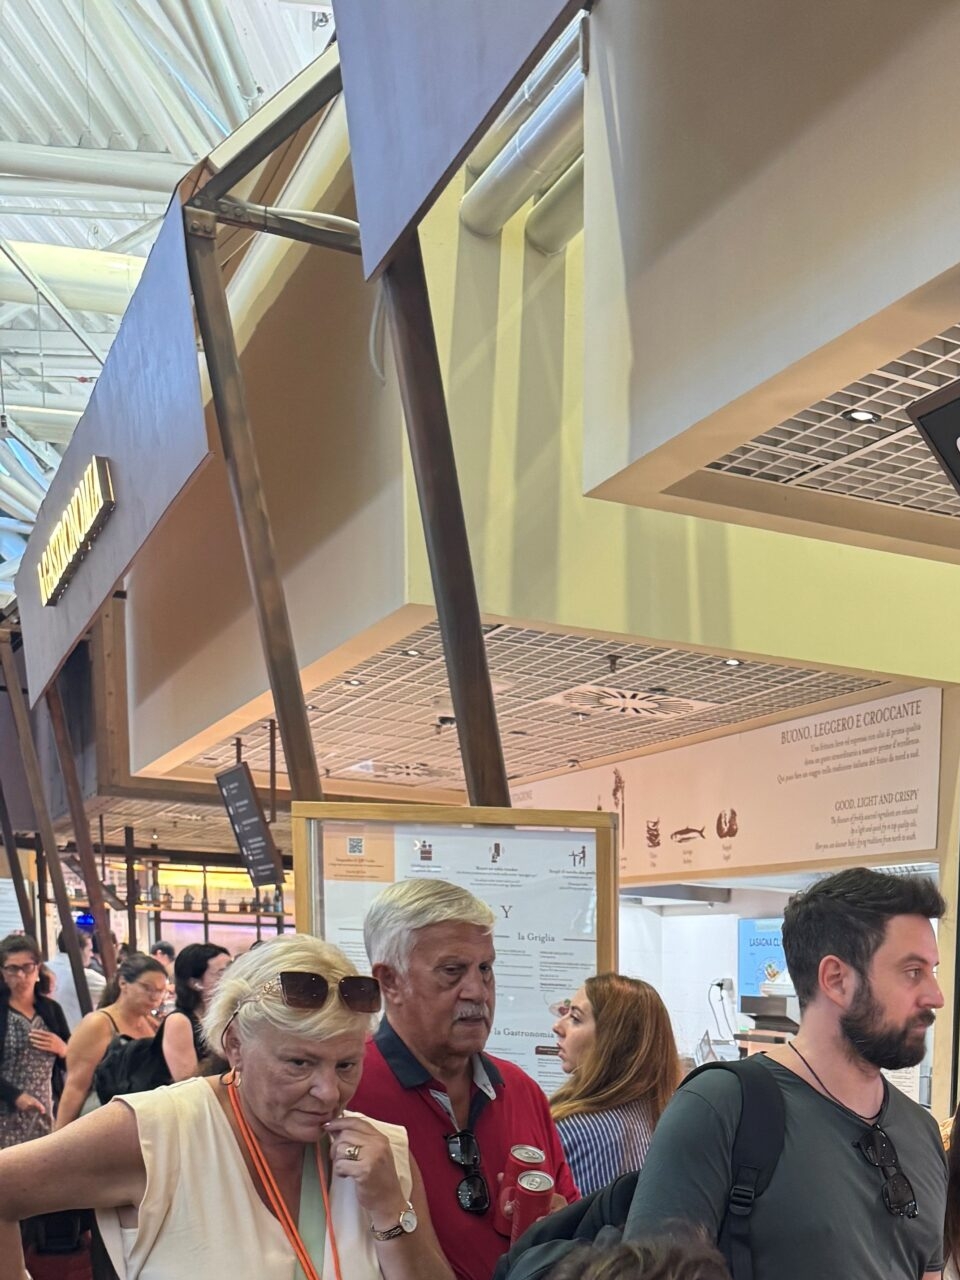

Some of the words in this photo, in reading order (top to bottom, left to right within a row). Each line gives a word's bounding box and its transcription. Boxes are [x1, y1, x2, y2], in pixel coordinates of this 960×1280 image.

[814, 715, 854, 738] LEGGERO
[856, 714, 862, 728] E
[863, 699, 922, 726] CROCCANTE
[857, 795, 878, 808] LIGHT
[878, 793, 894, 805] AND
[894, 788, 919, 803] CRISPY
[518, 932, 525, 941] la
[527, 933, 555, 944] Griglia
[494, 1027, 501, 1036] la
[503, 1028, 555, 1039] Gastronomia
